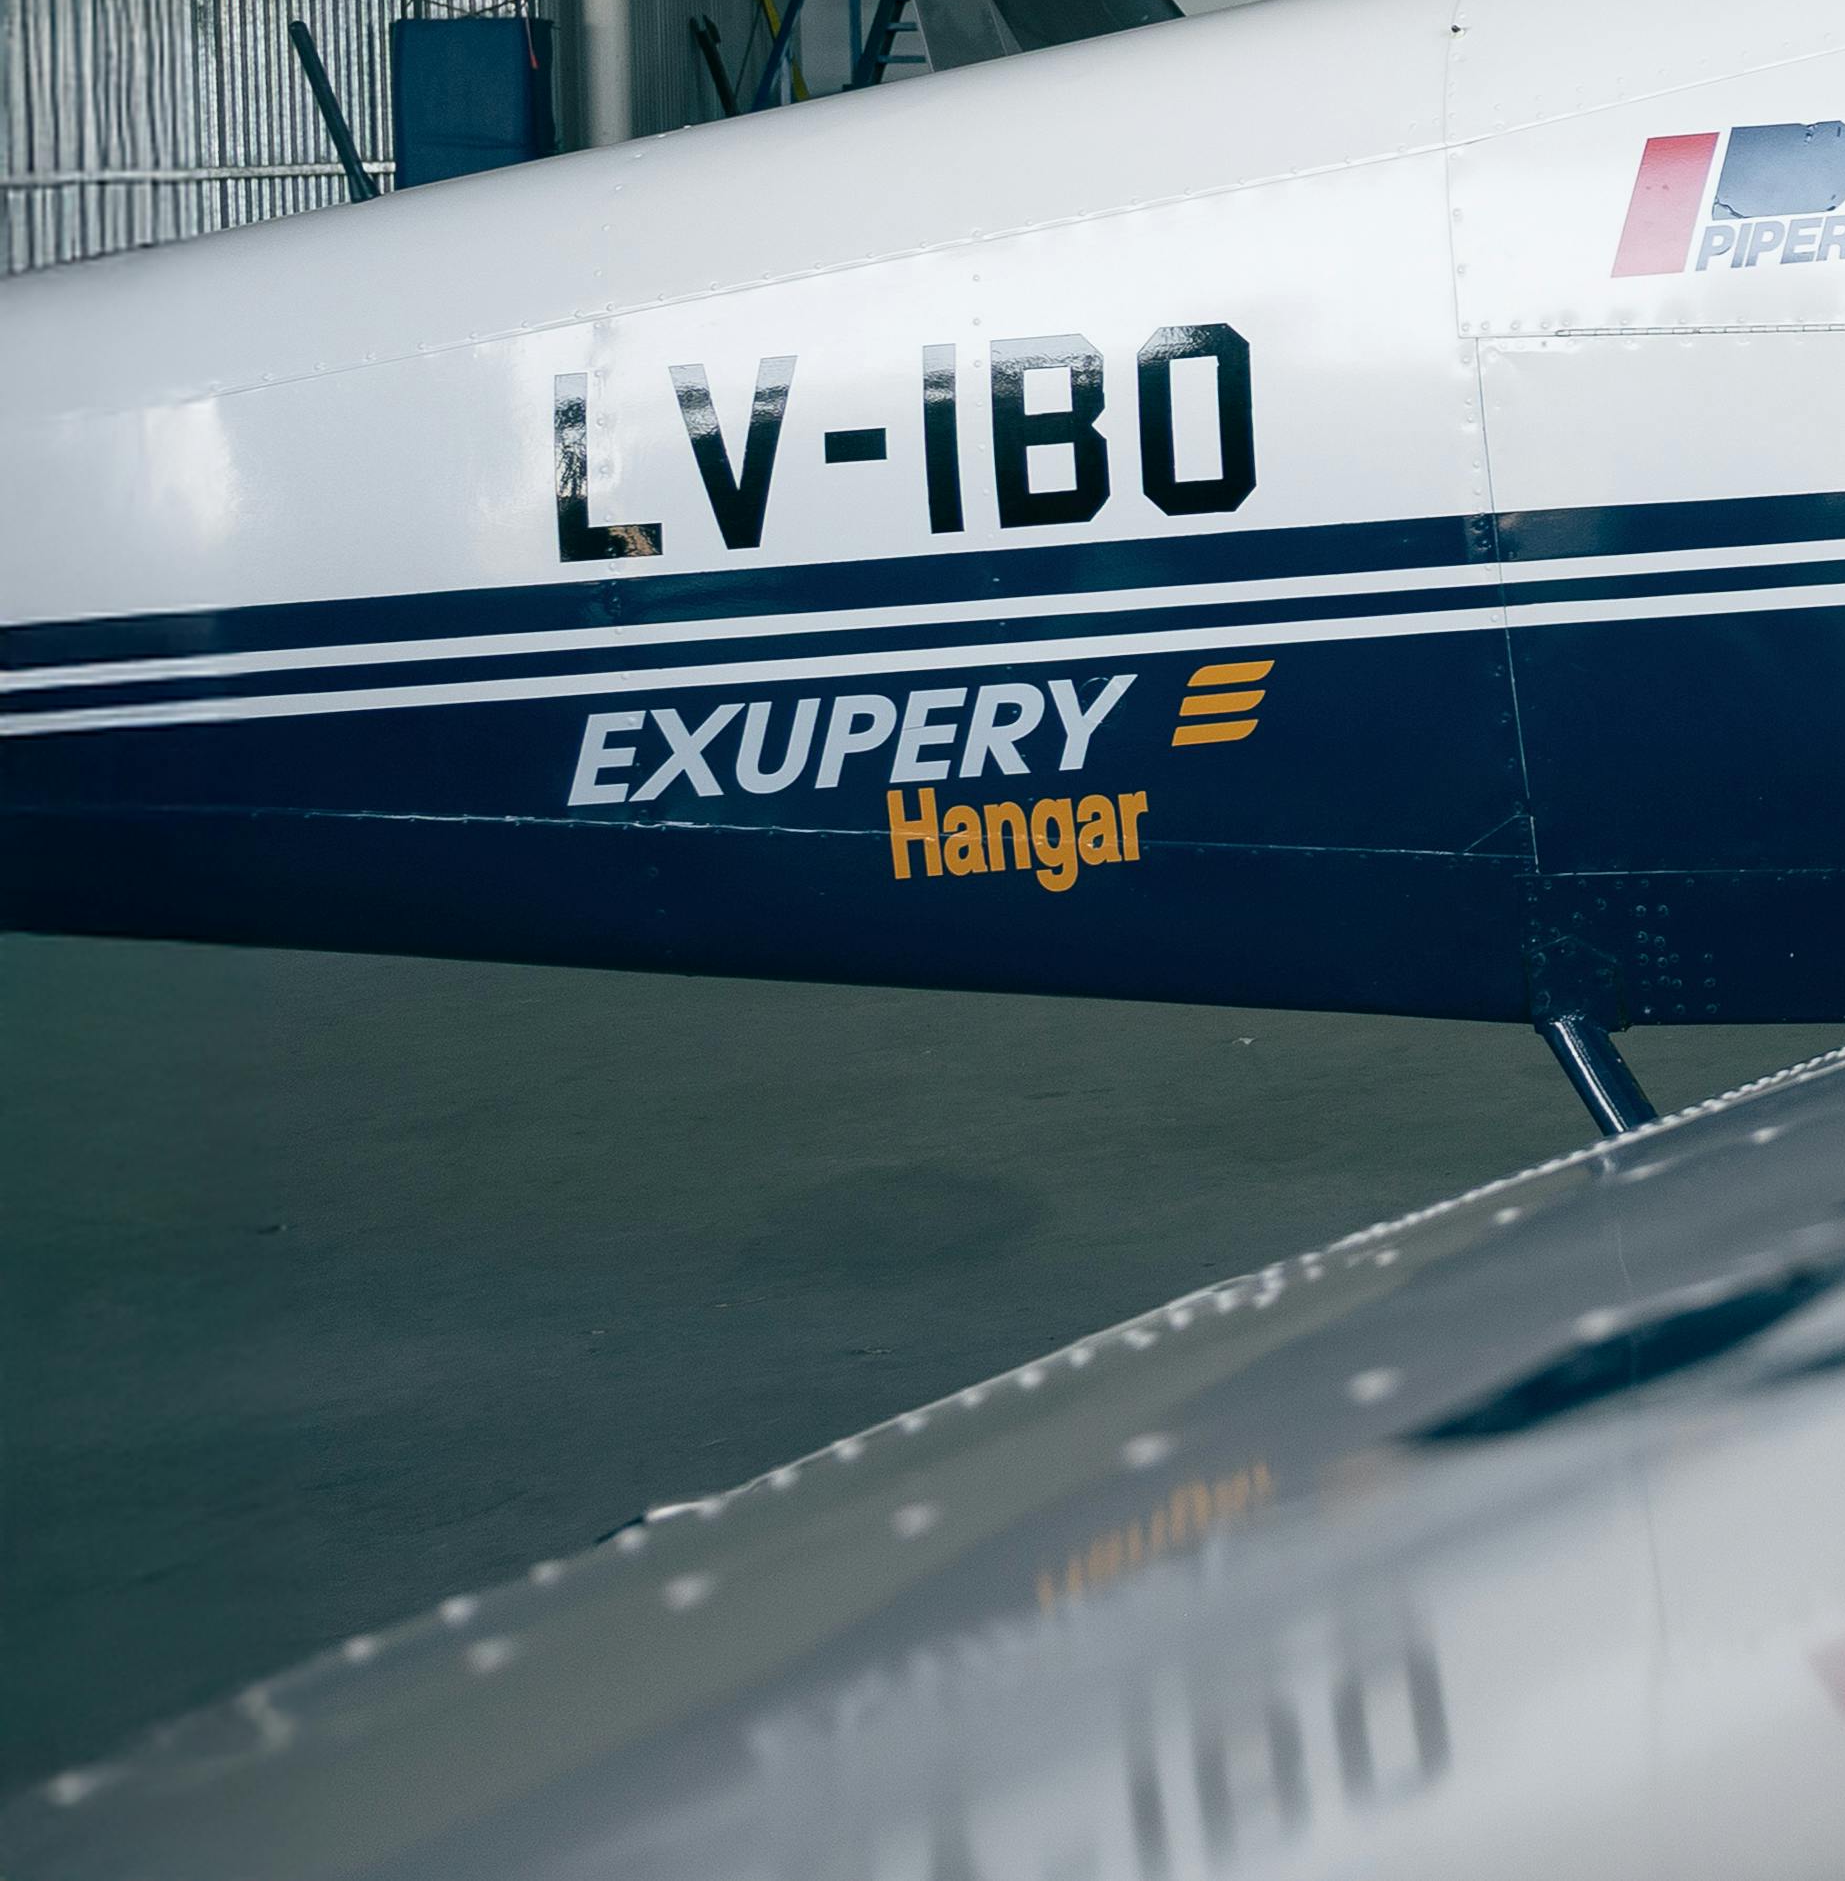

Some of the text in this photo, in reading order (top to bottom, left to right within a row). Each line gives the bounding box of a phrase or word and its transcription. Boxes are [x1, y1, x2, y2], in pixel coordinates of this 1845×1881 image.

[553, 322, 1258, 563] LV-IBO
[567, 674, 1139, 807] EXUPERY
[887, 787, 1149, 893] Hangar
